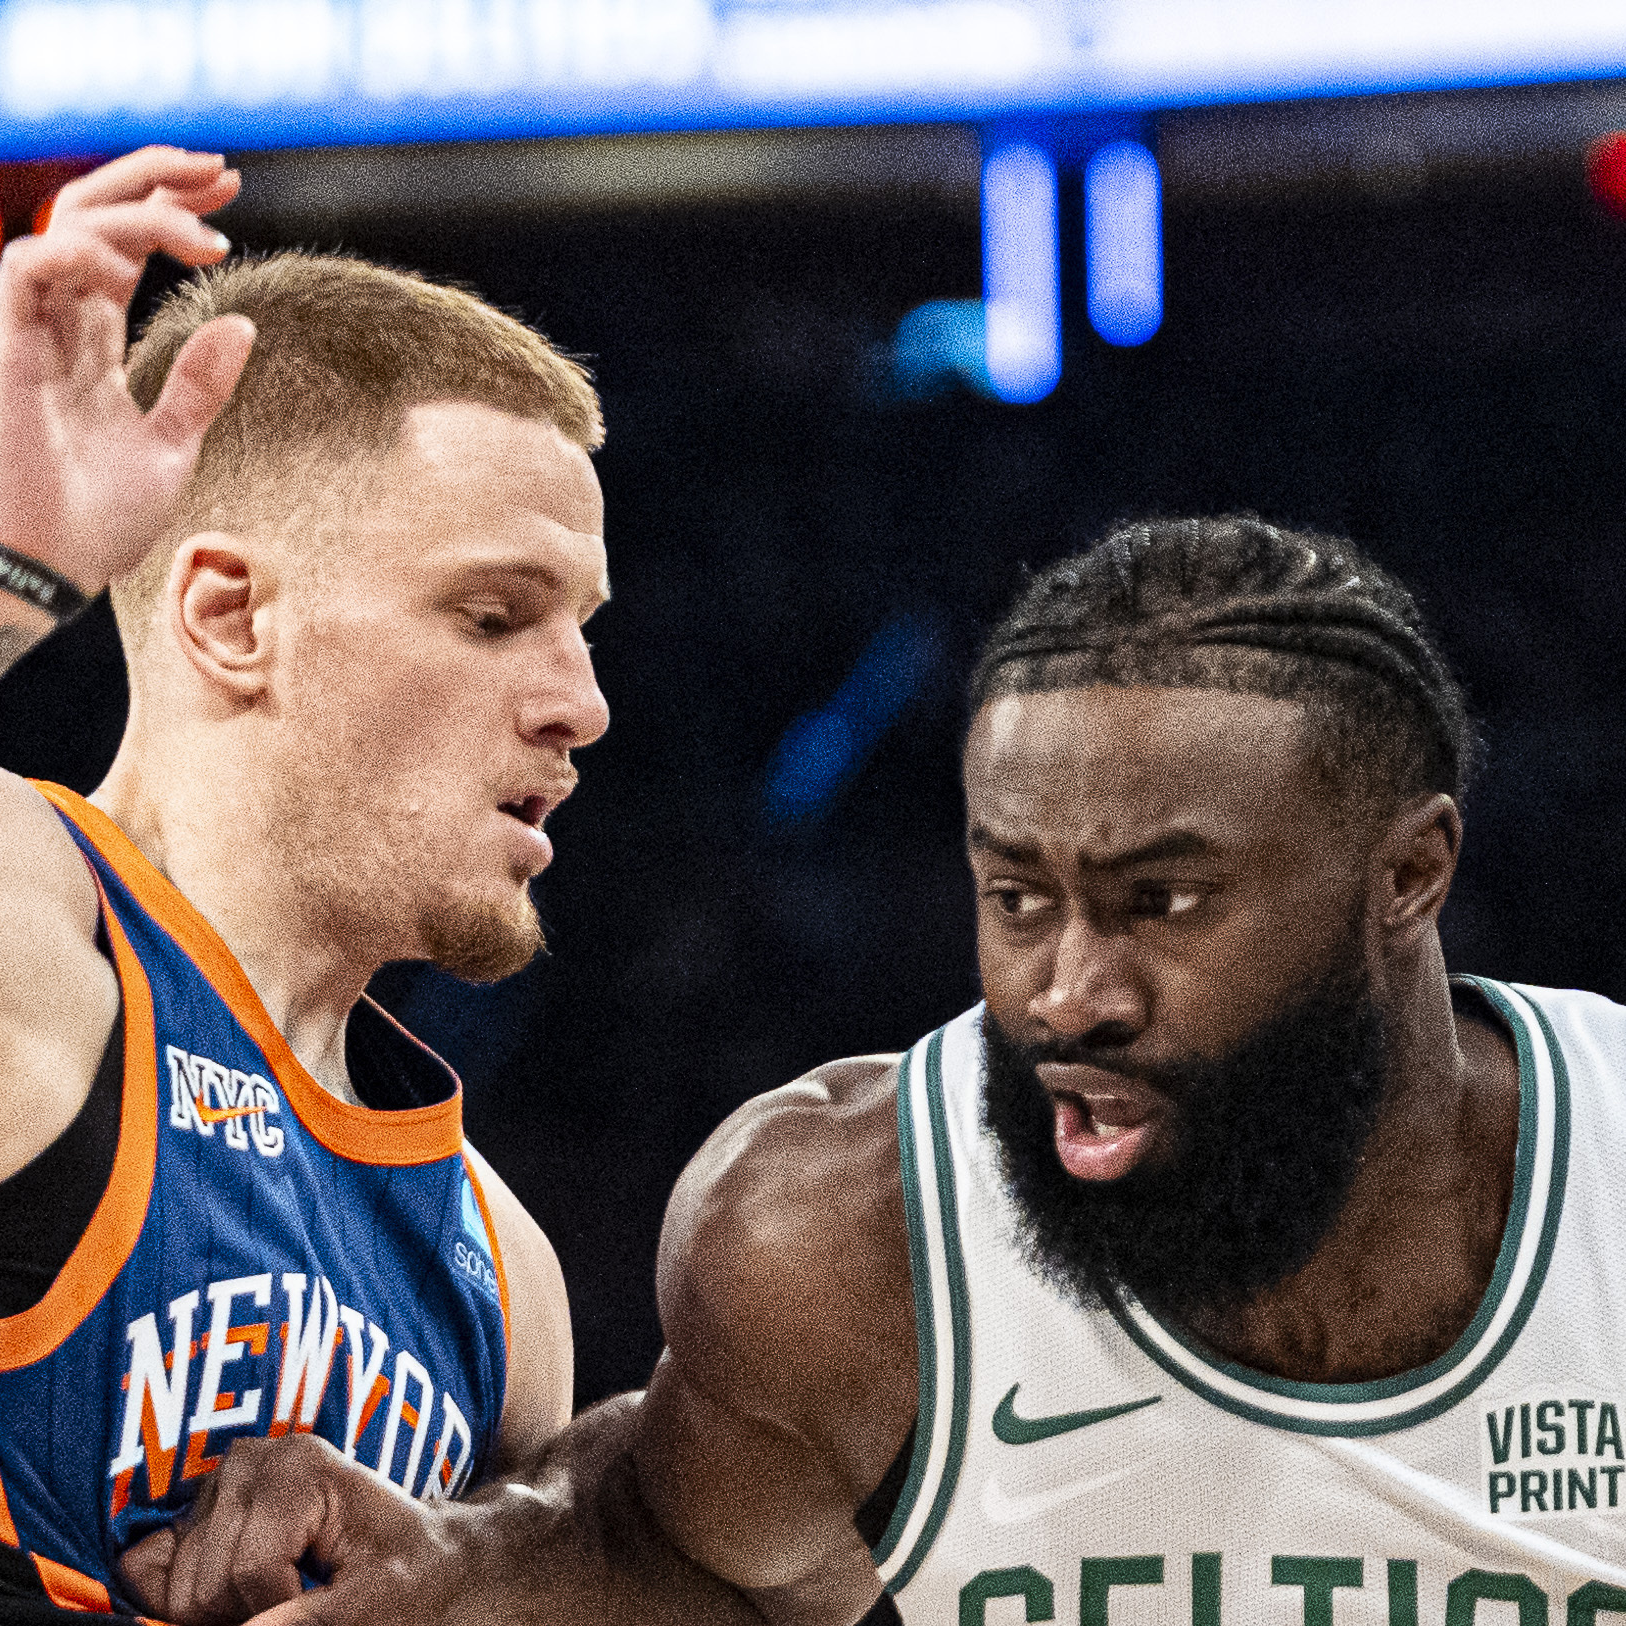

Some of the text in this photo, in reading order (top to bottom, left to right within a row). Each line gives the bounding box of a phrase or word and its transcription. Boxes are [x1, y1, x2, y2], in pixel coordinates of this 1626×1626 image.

[166, 1043, 285, 1157] NYC
[109, 1272, 474, 1500] NEW YOR
[1485, 1399, 1626, 1464] VISTA
